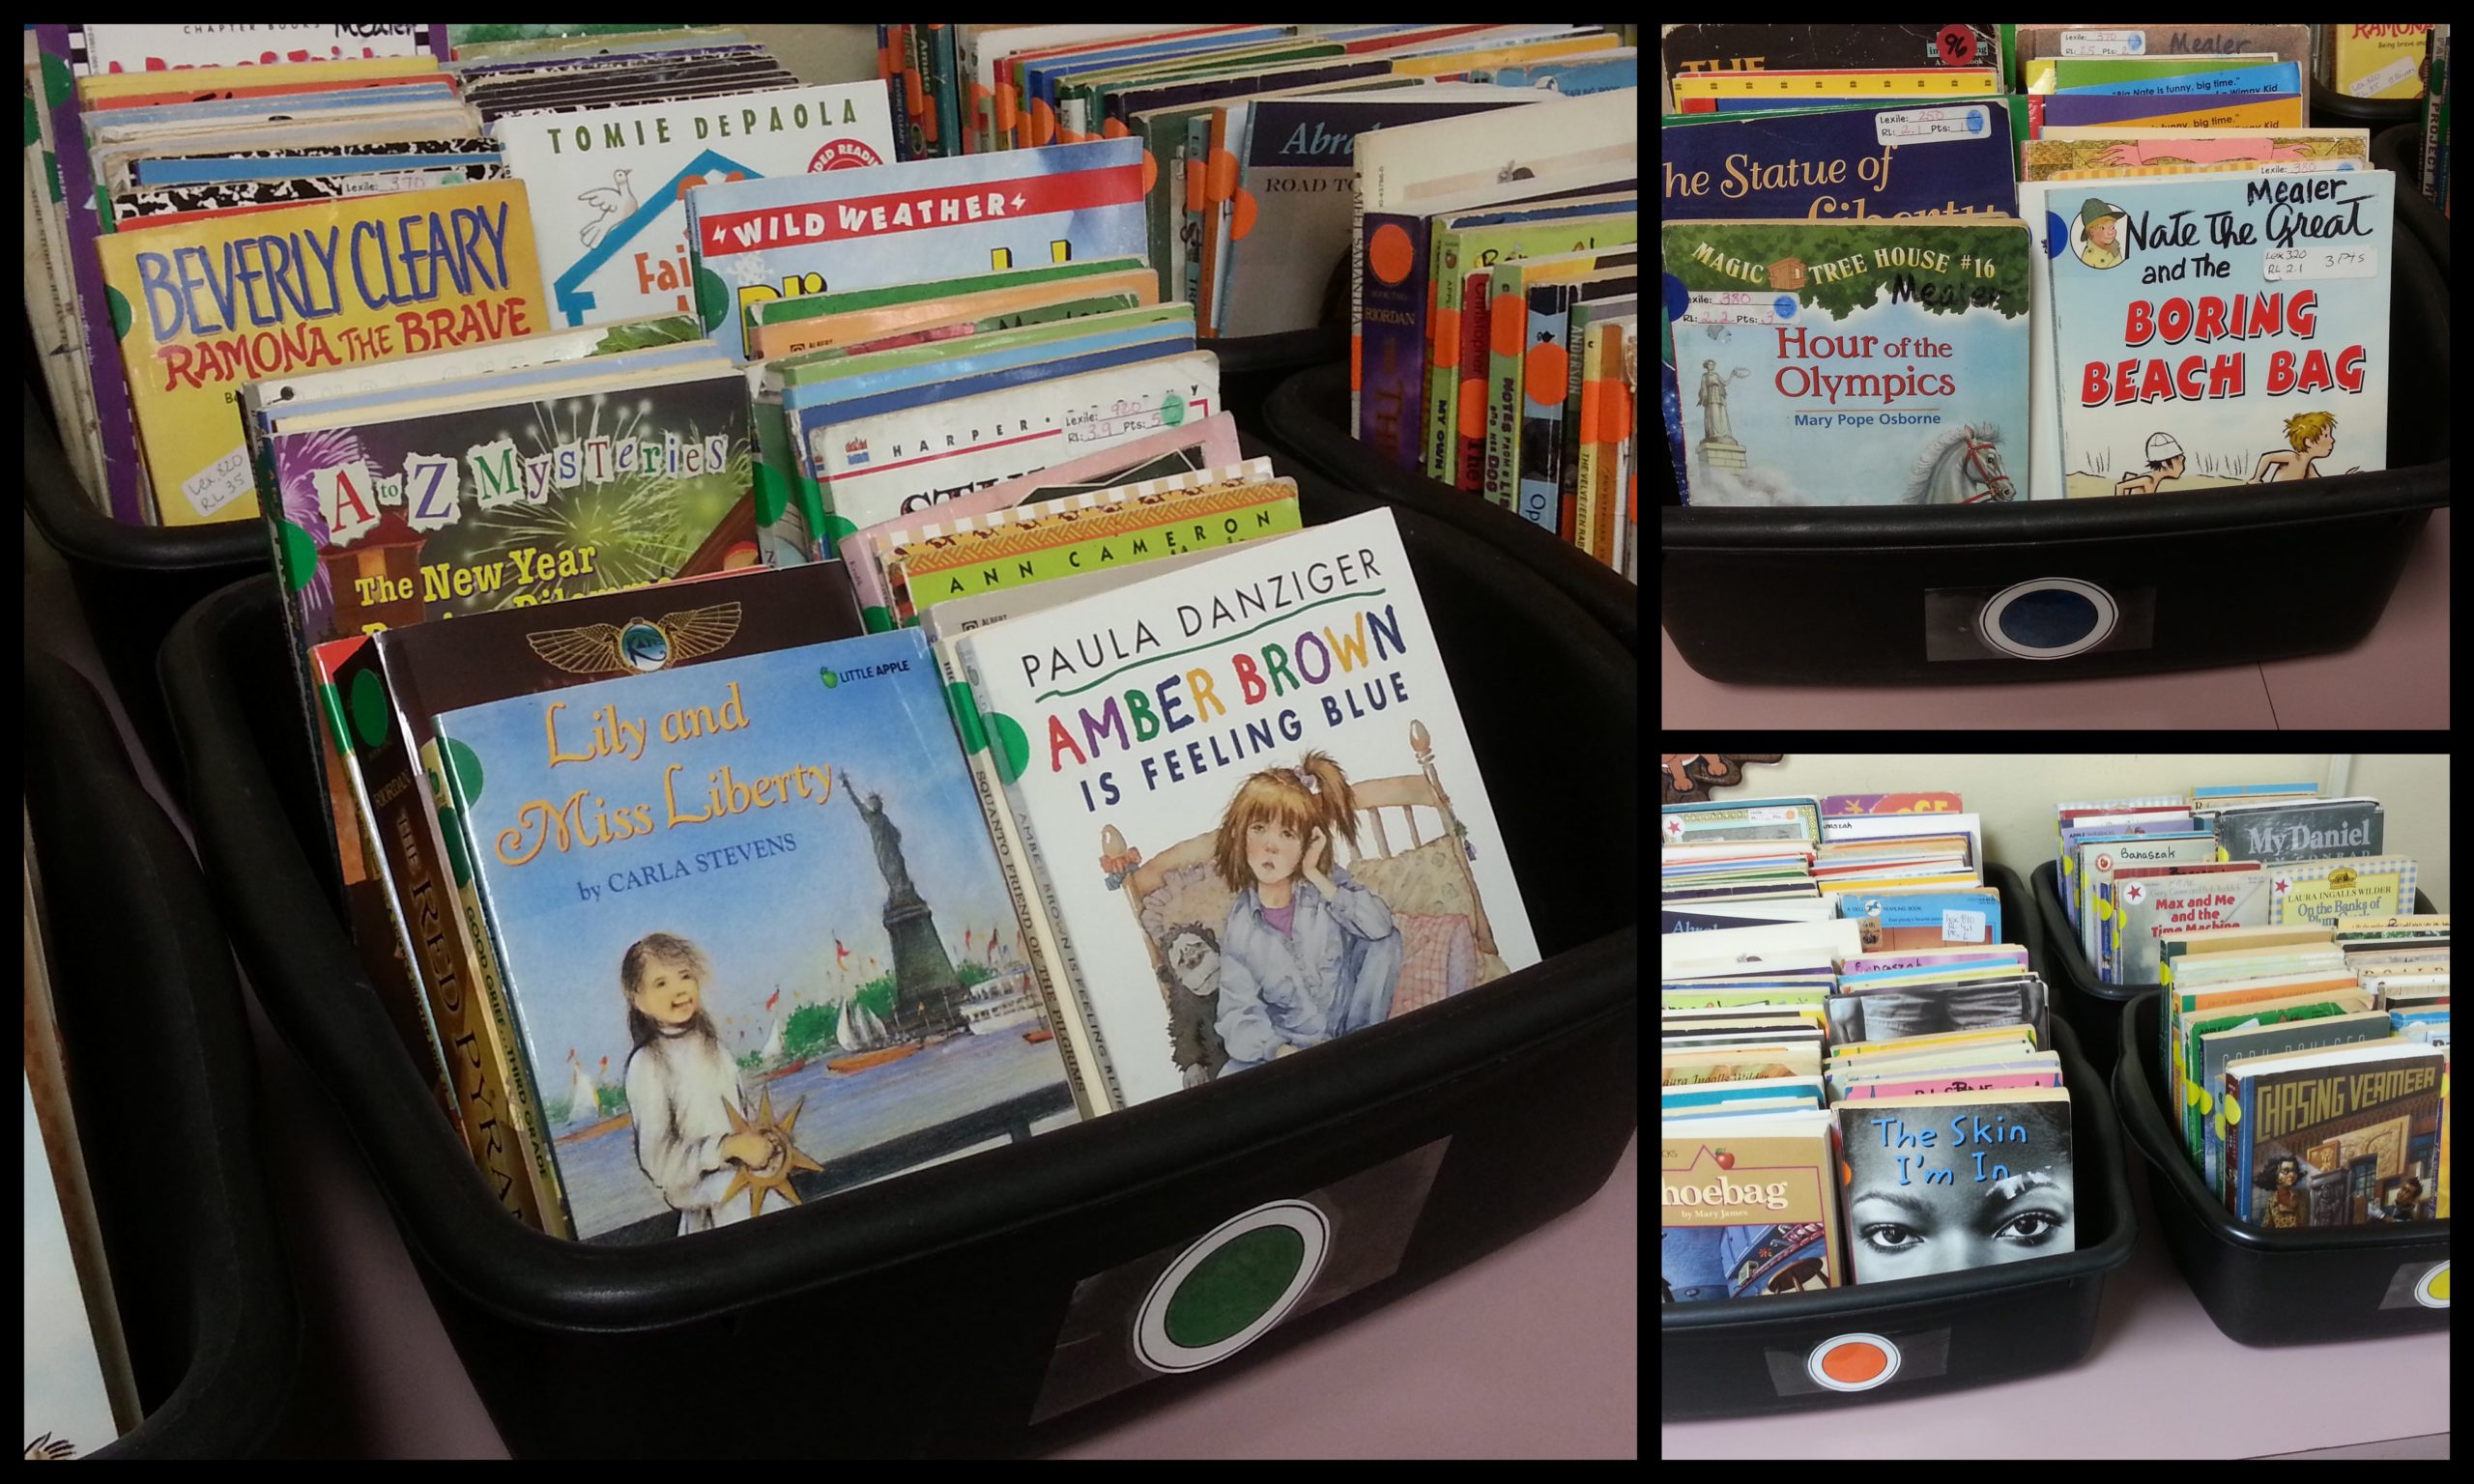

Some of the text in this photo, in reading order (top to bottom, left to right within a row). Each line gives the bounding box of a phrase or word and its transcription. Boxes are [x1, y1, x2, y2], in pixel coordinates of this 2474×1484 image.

[184, 23, 256, 35] CHAPTER
[2169, 32, 2253, 55] Mealer
[2165, 84, 2195, 95] funny,
[2196, 80, 2211, 91] big
[2263, 83, 2279, 93] Kid
[547, 117, 672, 155] TOMIE
[1880, 115, 1910, 125] Lexile:
[1930, 124, 1951, 133] Pts:
[2193, 118, 2209, 128] big
[2264, 120, 2280, 128] Kid
[2426, 101, 2441, 181] PROJECT
[346, 184, 379, 192] Lexile:
[1266, 177, 1327, 193] ROAD
[1662, 142, 1898, 199] he Statue of
[2260, 166, 2288, 175] Lexile:
[2247, 178, 2347, 206] Mealer
[732, 191, 1006, 248] WILD WEATHER
[2126, 209, 2201, 260] Nate
[2266, 193, 2378, 248] Great
[136, 224, 342, 344] BEVERLY
[350, 201, 510, 306] CLEARY
[1353, 193, 1365, 327] MEET SAMANTHA
[1691, 241, 1997, 286] MAGIC TREE HOUSE #16
[2142, 251, 2231, 285] and The
[2265, 248, 2335, 268] Lex 320 3
[2267, 264, 2281, 275] RL
[1365, 308, 1416, 326] RIORDAN
[1720, 292, 1752, 305] 380
[1471, 282, 1487, 374] Christopher
[1737, 314, 1758, 324] Pts:
[2124, 289, 2318, 347] BORING
[158, 322, 342, 391] RAMONA
[337, 323, 393, 357] THE
[394, 296, 532, 354] BRAVE
[1568, 324, 1584, 395] ANDERSON
[1774, 327, 1954, 358] Hour of the
[1774, 364, 1957, 405] Olympics
[2081, 344, 2367, 408] BEACH BAG
[1065, 412, 1099, 427] Lexile:
[1111, 401, 1142, 416] 920
[1123, 419, 1146, 432] Pts:
[1501, 377, 1515, 470] NOTES FROM
[1794, 413, 1942, 429] Mary Pope Osborne
[892, 418, 1028, 458] HARPER
[1434, 399, 1448, 470] MY OWN
[1466, 440, 1484, 481] The
[1486, 455, 1500, 494] DOG
[331, 468, 377, 534] A
[380, 477, 399, 499] to
[415, 462, 452, 519] Z
[949, 509, 1272, 594] ANN CAMERON
[355, 573, 415, 608] The
[420, 557, 503, 603] New
[508, 543, 597, 588] Year
[1021, 548, 1382, 689] PAULA DANZIGER
[839, 659, 911, 684] LITTLE APPLE
[1048, 603, 1408, 773] AMBER BROWN
[544, 680, 751, 769] Lily and
[1079, 671, 1410, 813] IS FEELING BLUE
[495, 762, 834, 868] Miss Liberty
[2248, 818, 2372, 857] My Daniel
[577, 832, 798, 902] by CARLA STEVENS
[2155, 893, 2236, 911] Max and Me
[2287, 885, 2393, 904] LAURA INGALLS WILDER
[2297, 896, 2381, 918] On the Banks of
[396, 815, 462, 1014] THE RED
[974, 769, 1087, 1094] SQUANTO FRIEND OF THE PILGRIMS
[2171, 907, 2221, 924] and the
[1017, 812, 1108, 1061] AMBER BROWN FEELING
[465, 905, 549, 1180] GOOD THIRD GRADE
[2199, 1027, 2222, 1036] APPLE
[2256, 1066, 2436, 1146] CHASING VERMEER
[1871, 1113, 2029, 1149] The Skin
[1896, 1150, 2010, 1187] I'm In
[1662, 1176, 1789, 1210] hoebag
[1682, 1210, 1749, 1220] by Mary James
